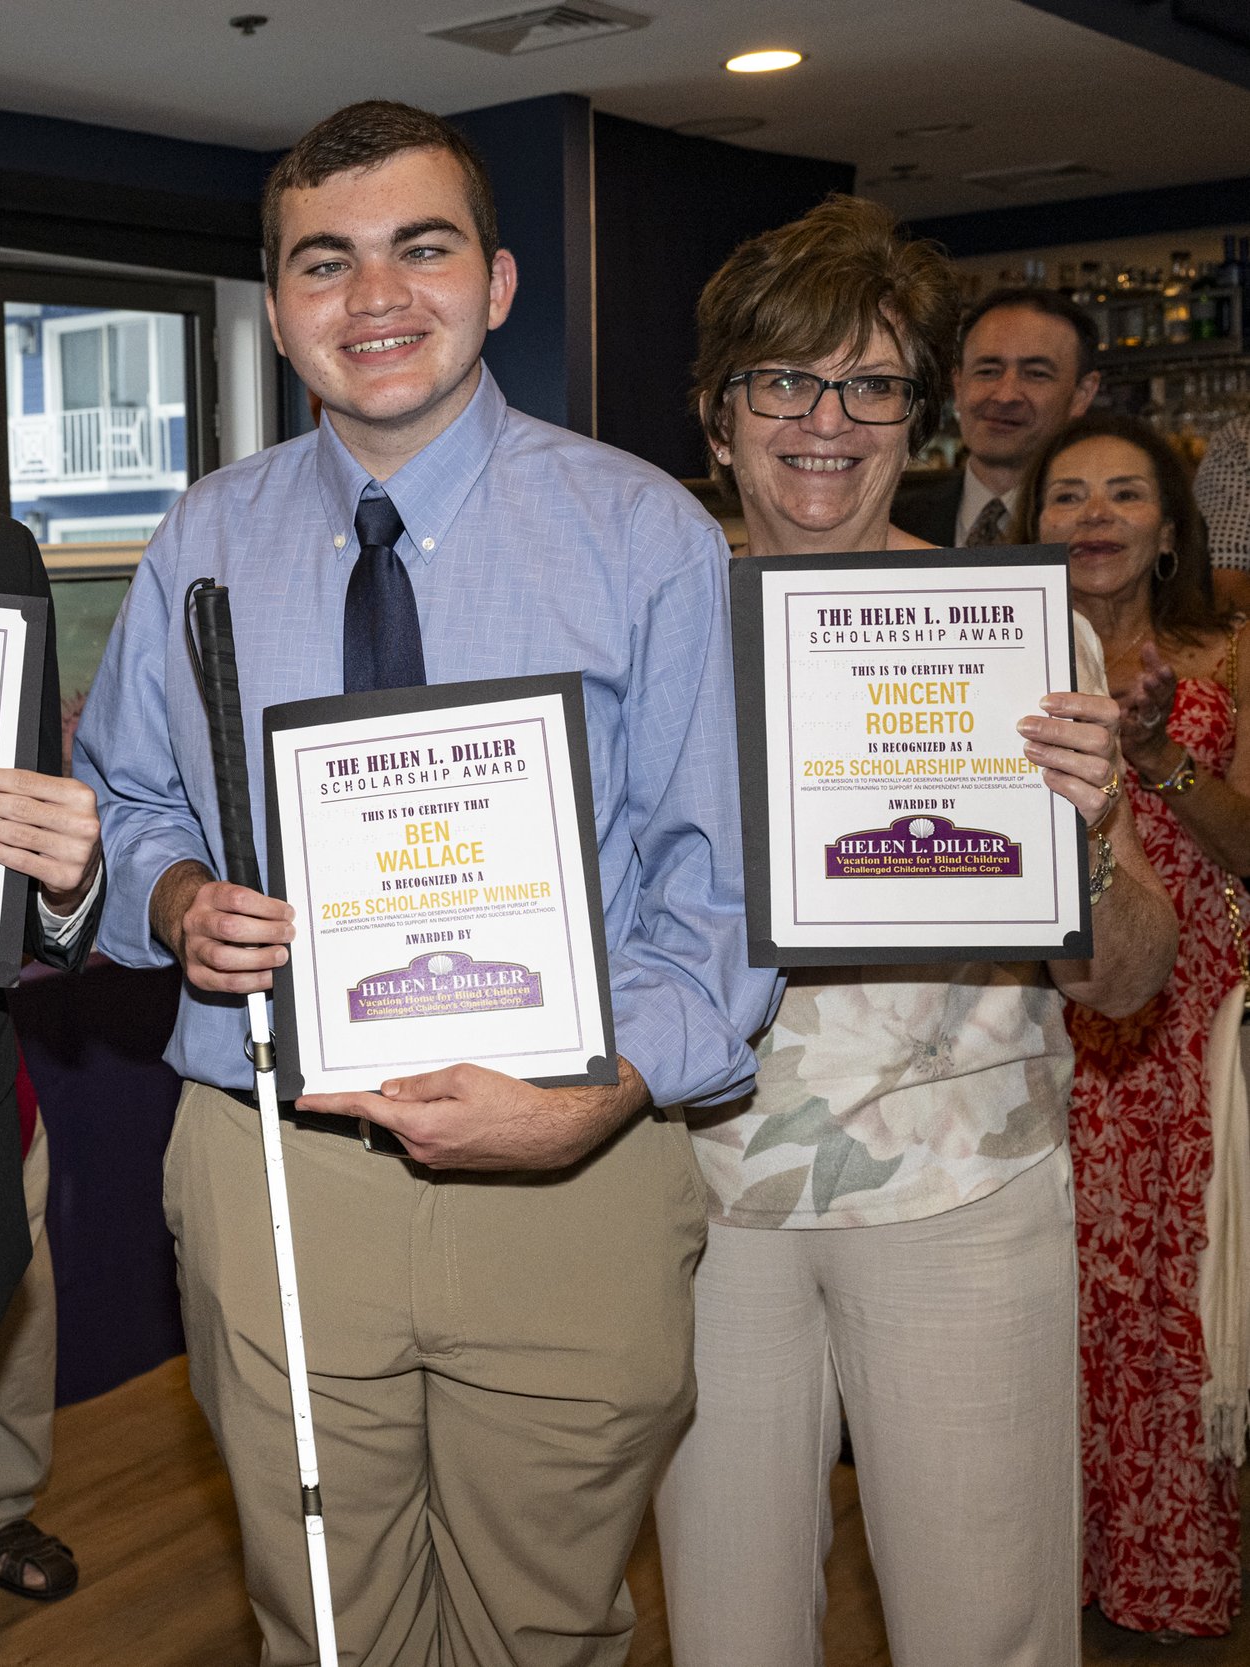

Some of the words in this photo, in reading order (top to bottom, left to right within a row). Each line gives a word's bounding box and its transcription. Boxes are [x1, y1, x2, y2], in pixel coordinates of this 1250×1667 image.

[817, 608, 853, 627] THE
[860, 607, 916, 626] HELEN
[924, 607, 941, 625] L.
[948, 605, 1015, 624] DILLER
[810, 629, 946, 644] SCHOLARSHIP
[959, 627, 1023, 641] AWARD
[851, 665, 876, 677] THIS
[879, 665, 889, 676] IS
[893, 665, 907, 676] TO
[911, 664, 954, 676] CERTIFY
[958, 663, 985, 675] THAT
[867, 681, 971, 706] VINCENT
[866, 710, 975, 735] ROBERTO
[868, 742, 878, 753] IS
[882, 741, 946, 753] RECOGNIZED
[950, 741, 963, 752] AS
[966, 741, 973, 752] A
[325, 757, 360, 778] THE
[366, 749, 420, 773] HELEN
[427, 748, 444, 766] L.
[451, 738, 517, 763] DILLER
[803, 759, 845, 777] 2025
[849, 758, 967, 777] SCHOLARSHIP
[971, 756, 1039, 775] WINNER
[320, 768, 450, 796] SCHOLARSHIP
[463, 759, 526, 778] AWARD
[361, 810, 385, 823] THIS
[388, 808, 398, 819] IS
[400, 806, 415, 818] TO
[418, 801, 460, 816] CERTIFY
[463, 798, 490, 811] THAT
[888, 798, 938, 810] AWARDED
[941, 798, 956, 809] BY
[405, 820, 450, 846] BEN
[376, 841, 485, 873] WALLACE
[840, 839, 905, 854] HELEN
[911, 839, 928, 854] L.
[932, 839, 1006, 853] DILLER
[836, 856, 880, 865] Vacation
[883, 856, 914, 865] Home
[916, 855, 932, 864] for
[934, 855, 962, 864] Blind
[964, 855, 1010, 864] Children
[843, 866, 892, 875] Challenged
[893, 865, 937, 873] Children's
[938, 865, 978, 873] Charities
[979, 865, 1002, 874] Corp.
[381, 880, 392, 891] IS
[395, 873, 458, 890] RECOGNIZED
[461, 871, 474, 883] AS
[477, 871, 484, 882] A
[321, 900, 361, 920] 2025
[364, 888, 479, 915] SCHOLARSHIP
[482, 881, 551, 903] WINNER
[405, 930, 454, 945] AWARDED
[457, 929, 471, 940] BY
[362, 977, 426, 997] HELEN
[430, 976, 449, 992] L.
[452, 969, 525, 990] DILLER
[358, 997, 404, 1007] Vacation
[405, 995, 435, 1006] Home
[435, 992, 453, 1002] for
[453, 988, 483, 1000] Blind
[482, 986, 530, 998] Children
